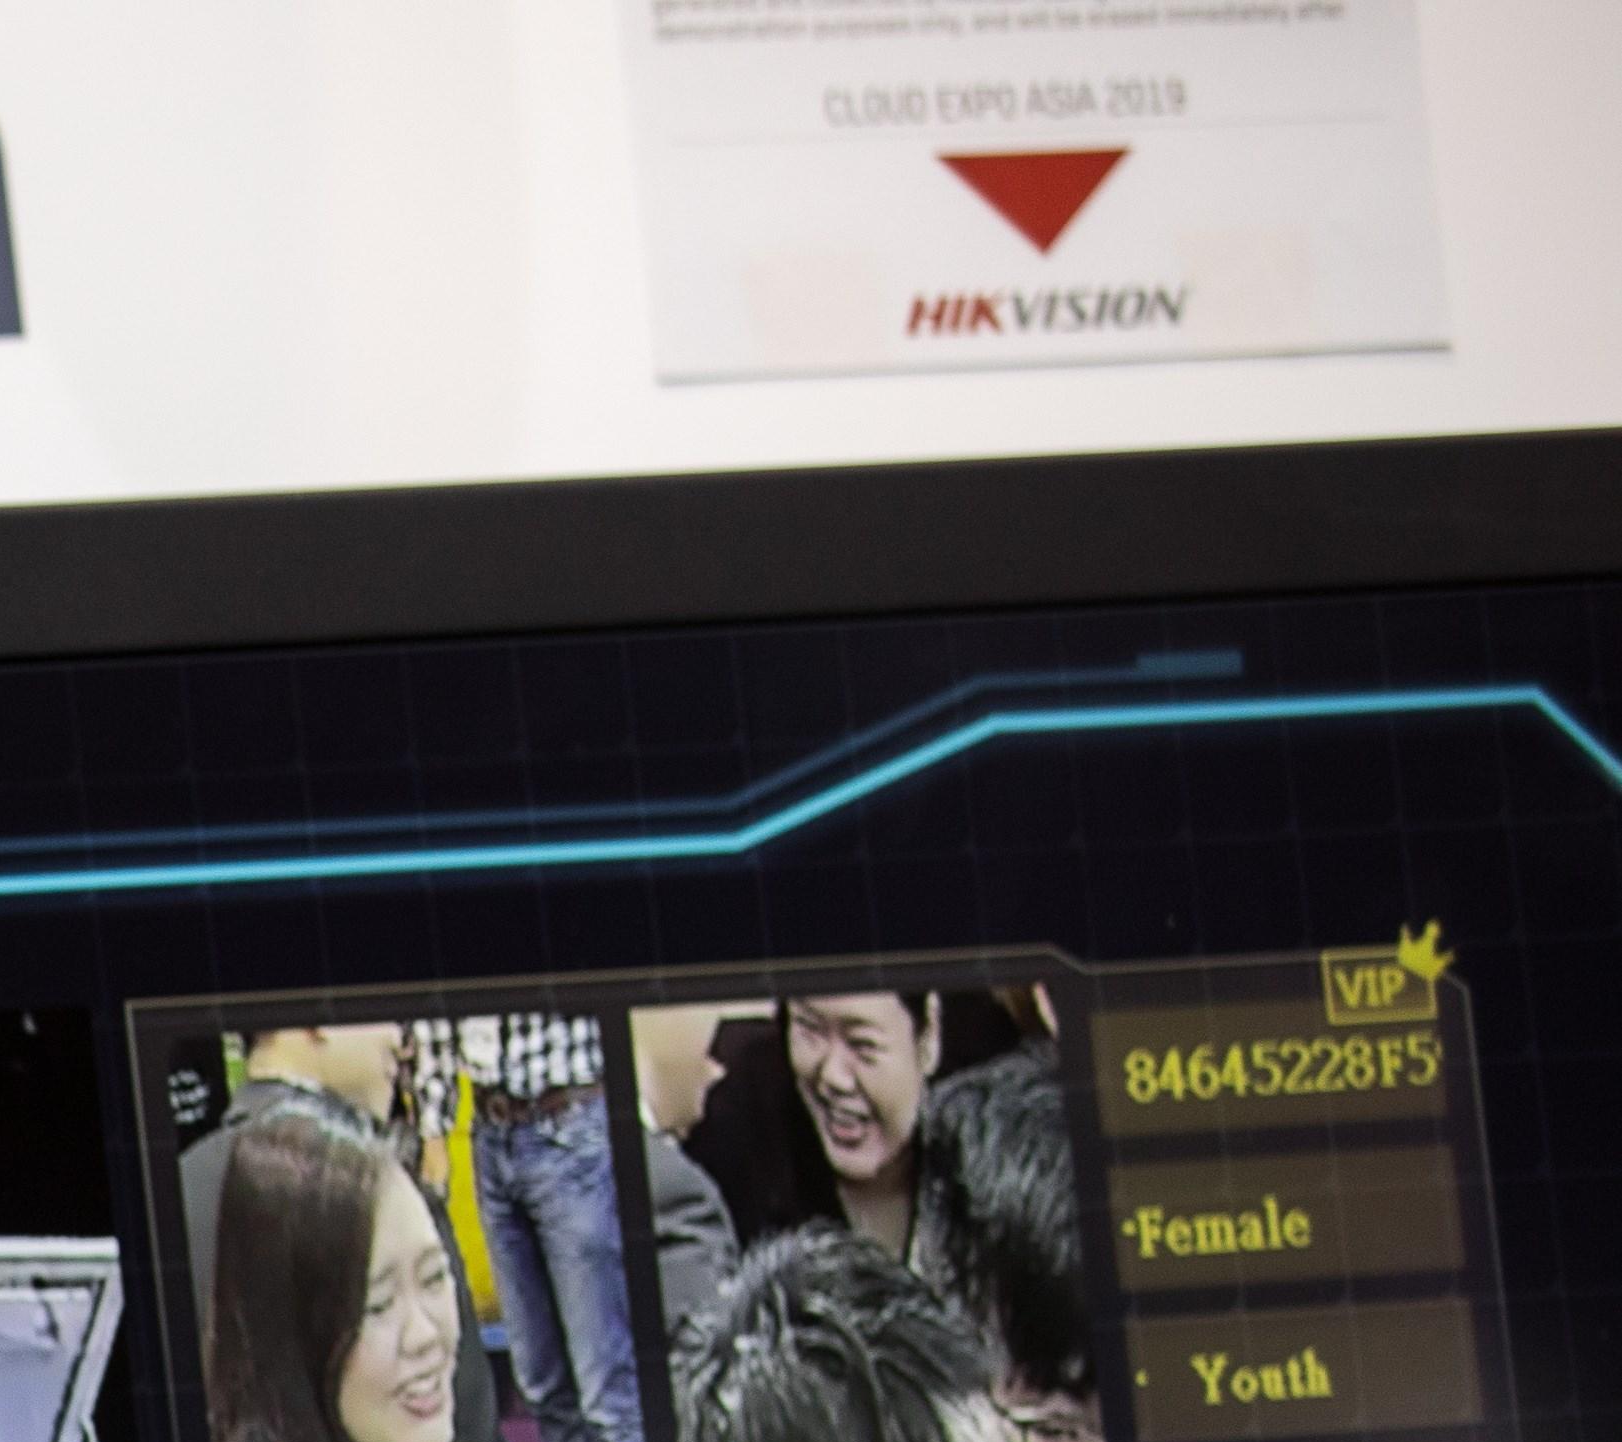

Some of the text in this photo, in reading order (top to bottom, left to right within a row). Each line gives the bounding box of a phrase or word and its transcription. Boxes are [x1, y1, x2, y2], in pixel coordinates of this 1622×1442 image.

[823, 72, 1188, 128] CLOUD EXPO ASIA 2019
[906, 285, 1189, 338] HIKVISION
[1335, 966, 1405, 1009] VIP
[1124, 1034, 1437, 1102] 84645228F5
[1136, 1198, 1309, 1257] Female
[1192, 1350, 1330, 1404] Youth
